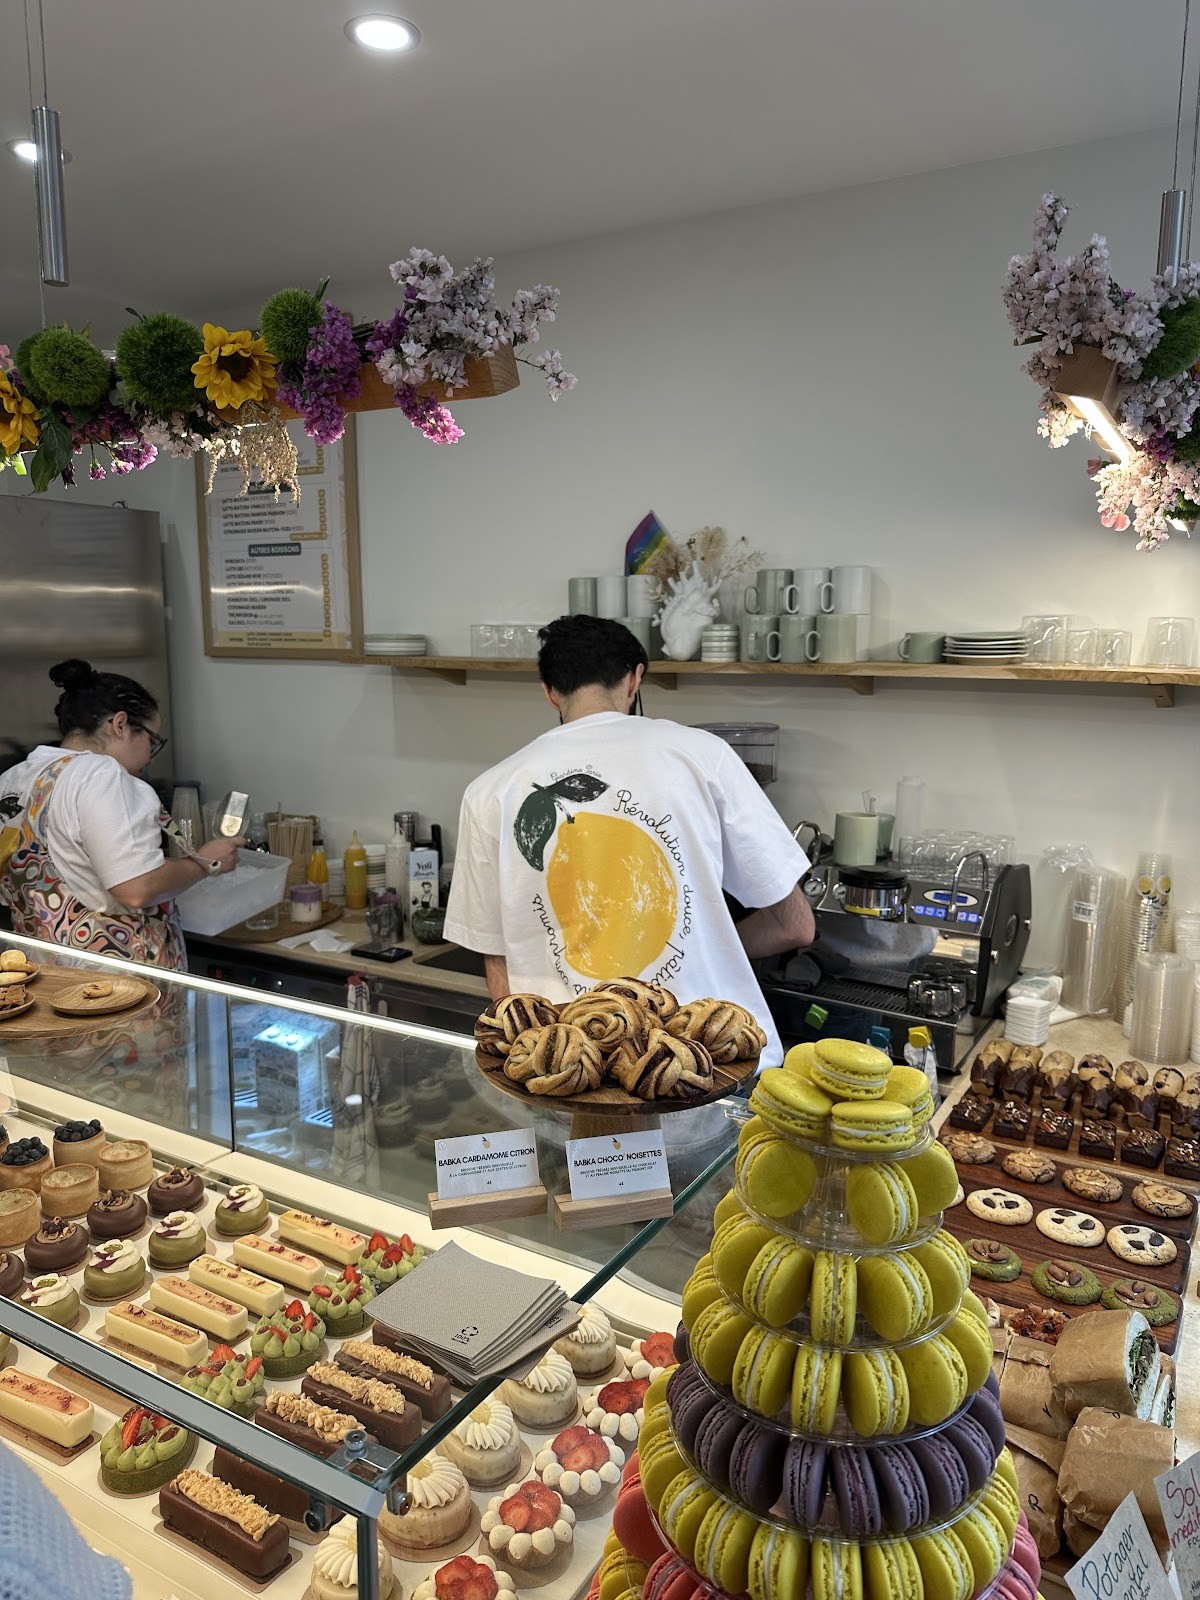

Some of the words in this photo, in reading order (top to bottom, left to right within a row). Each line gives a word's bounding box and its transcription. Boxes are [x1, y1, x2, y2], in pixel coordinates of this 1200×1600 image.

[250, 546, 271, 555] AUTRES
[271, 545, 300, 554] BOISSONS
[613, 789, 686, 877] Révolution
[532, 893, 569, 985] compromis
[679, 884, 694, 939] douce,
[438, 1157, 462, 1167] BABKA
[462, 1151, 509, 1164] CARDAMOME
[509, 1147, 535, 1157] CITRON
[573, 1158, 597, 1167] BABKA
[626, 1149, 662, 1160] NOISETTES
[1081, 1524, 1136, 1600] Potager
